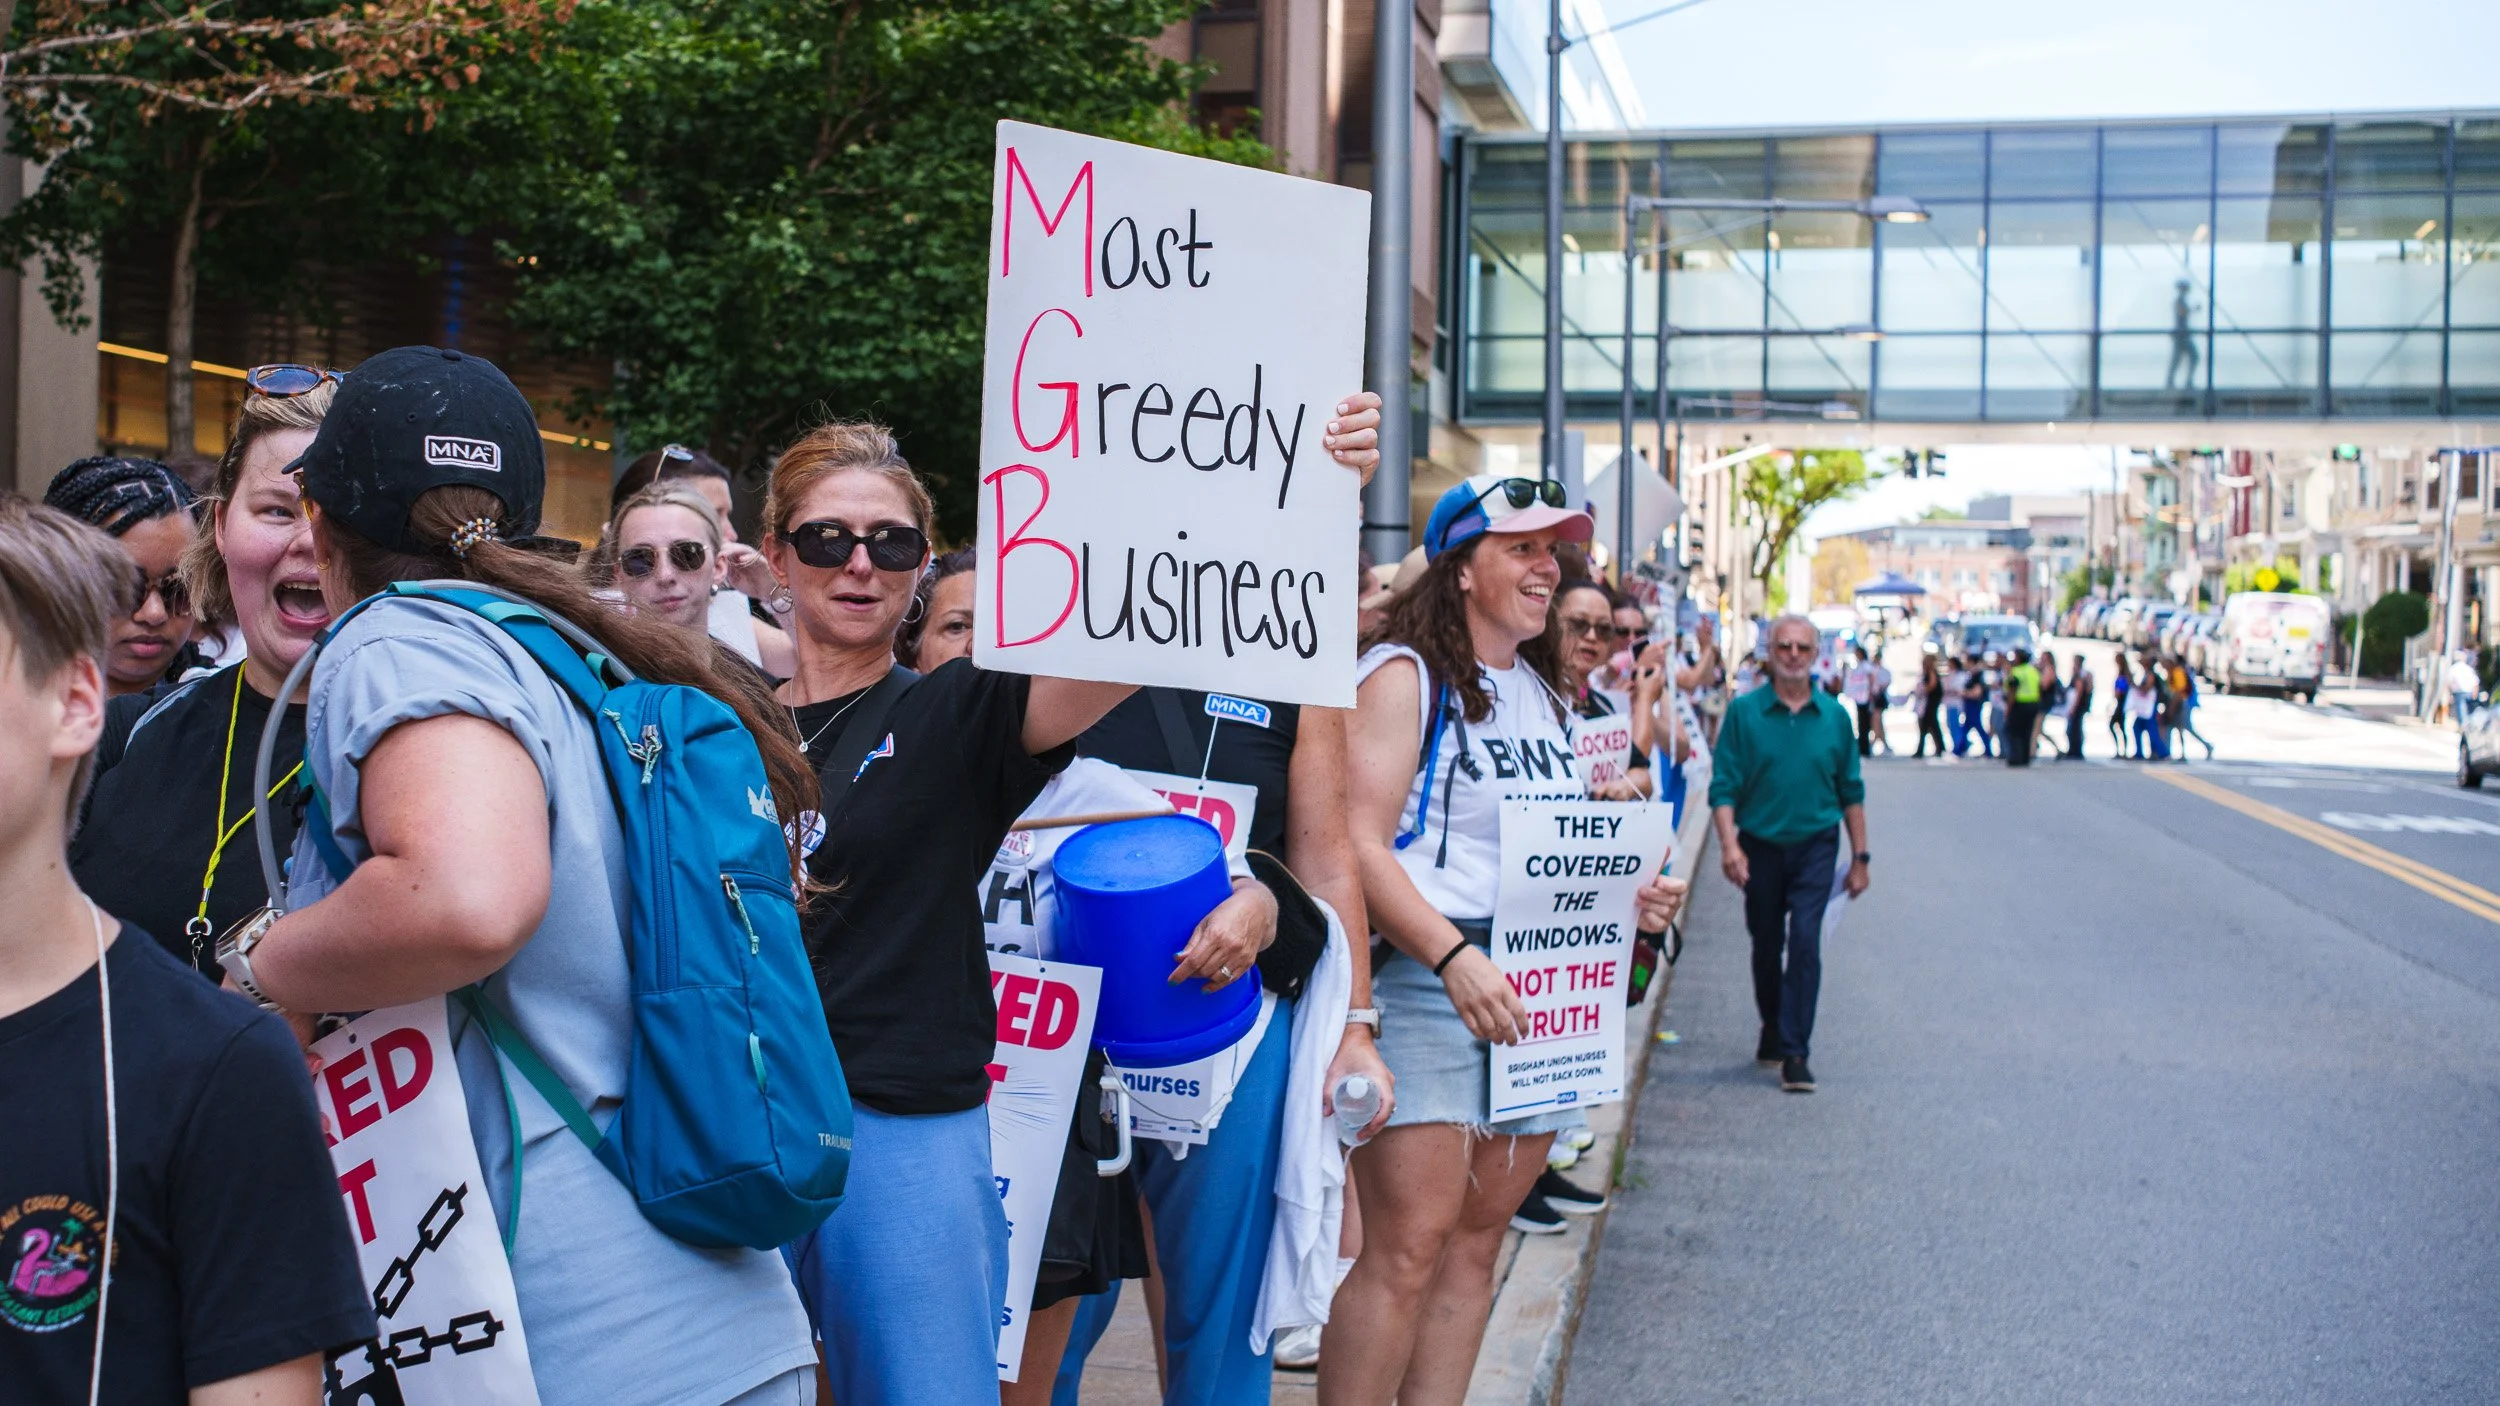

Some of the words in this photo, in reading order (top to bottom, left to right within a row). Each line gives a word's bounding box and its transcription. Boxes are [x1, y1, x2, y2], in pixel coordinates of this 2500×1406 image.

[1003, 147, 1213, 297] Most
[1011, 308, 1305, 509] Greedy
[430, 441, 492, 462] MNA
[983, 464, 1325, 659] Business
[1211, 697, 1260, 720] MNA
[1573, 728, 1628, 757] LOCKED
[1555, 816, 1622, 839] THEY
[1525, 855, 1641, 878] COVERED
[1552, 891, 1598, 913] THE
[1505, 923, 1623, 954] WINDOWS.
[1504, 966, 1561, 999] NOT
[1566, 961, 1617, 992] THE
[1519, 1004, 1600, 1040] RUTH
[1508, 1059, 1545, 1074] BRIGHAM
[1547, 1055, 1573, 1068] UNION
[1575, 1049, 1607, 1063] NURSES
[1122, 1072, 1200, 1097] nurses
[1511, 1077, 1531, 1089] WILL
[1533, 1074, 1550, 1085] NOT
[1552, 1070, 1574, 1082] BACK
